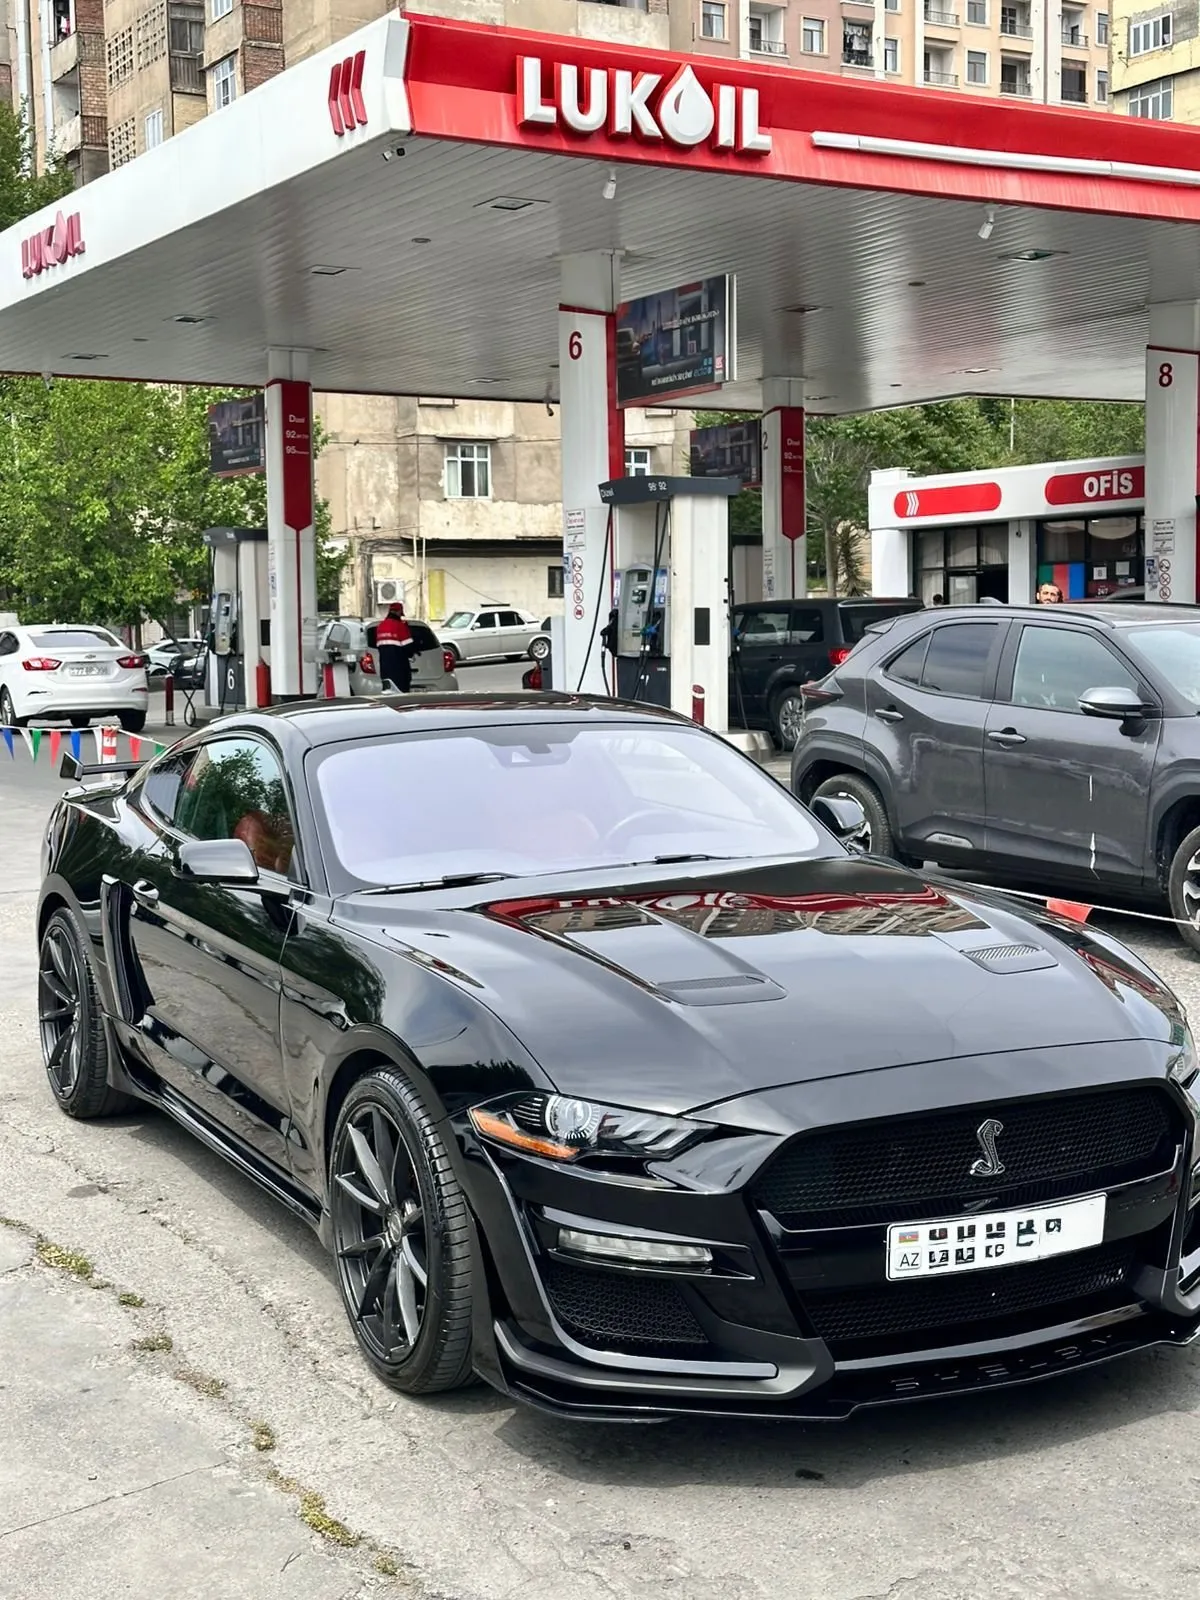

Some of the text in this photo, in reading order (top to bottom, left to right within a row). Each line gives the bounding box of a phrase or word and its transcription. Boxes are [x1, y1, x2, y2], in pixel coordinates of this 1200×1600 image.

[516, 55, 772, 155] LUKOIL
[568, 331, 583, 360] 6
[1158, 363, 1173, 387] 8
[1083, 470, 1134, 498] OFİS
[227, 668, 235, 690] 6
[899, 1252, 920, 1268] AZ
